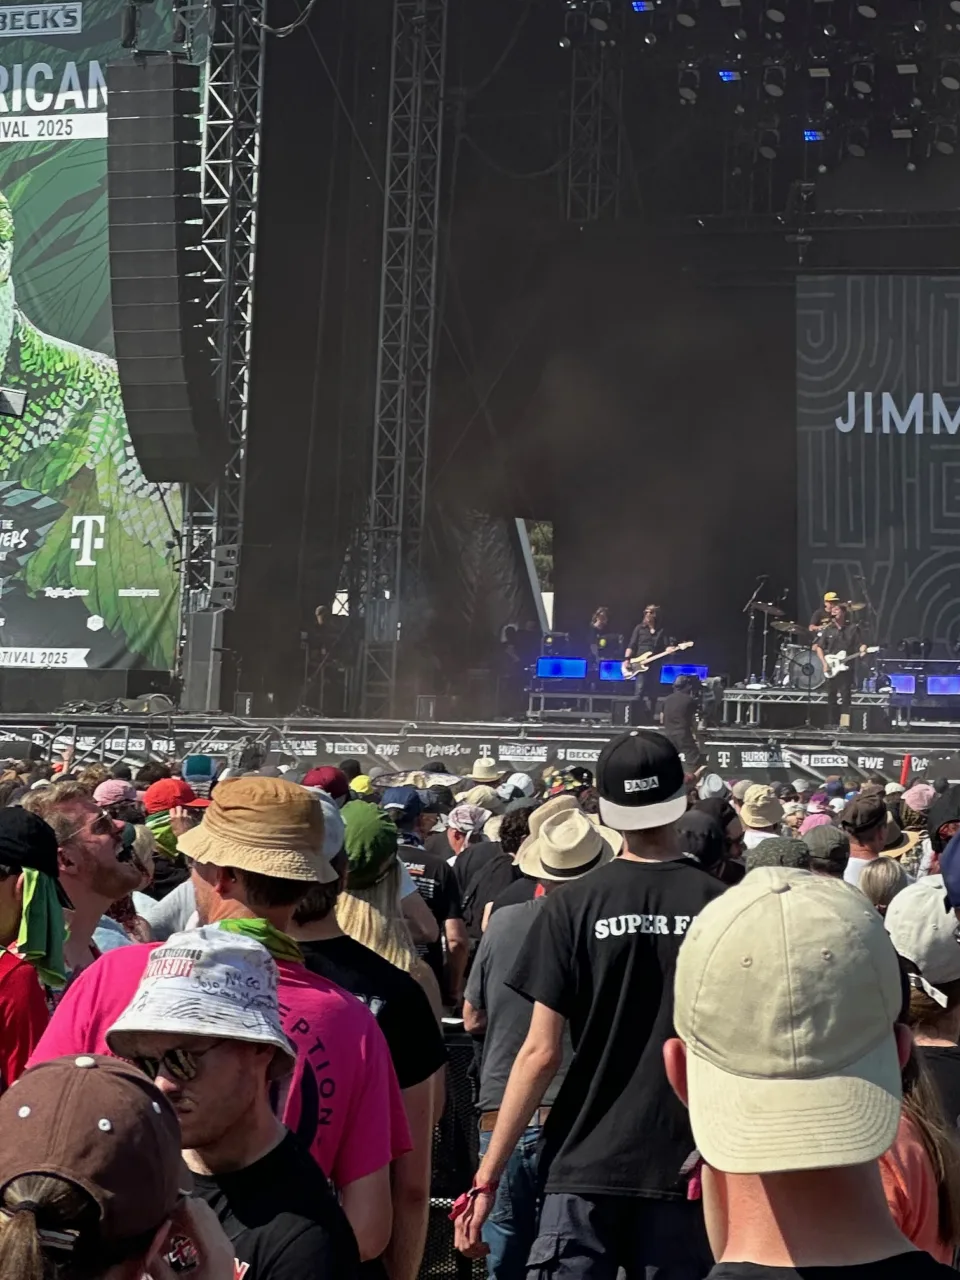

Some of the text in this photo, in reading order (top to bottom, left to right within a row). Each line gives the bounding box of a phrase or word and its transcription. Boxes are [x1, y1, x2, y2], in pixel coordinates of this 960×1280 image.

[37, 118, 73, 137] 2025
[40, 651, 68, 664] 2025
[425, 743, 461, 757] PLAYERS
[498, 745, 548, 757] HURRICANE
[857, 757, 884, 769] EWE
[594, 914, 670, 939] SUPER
